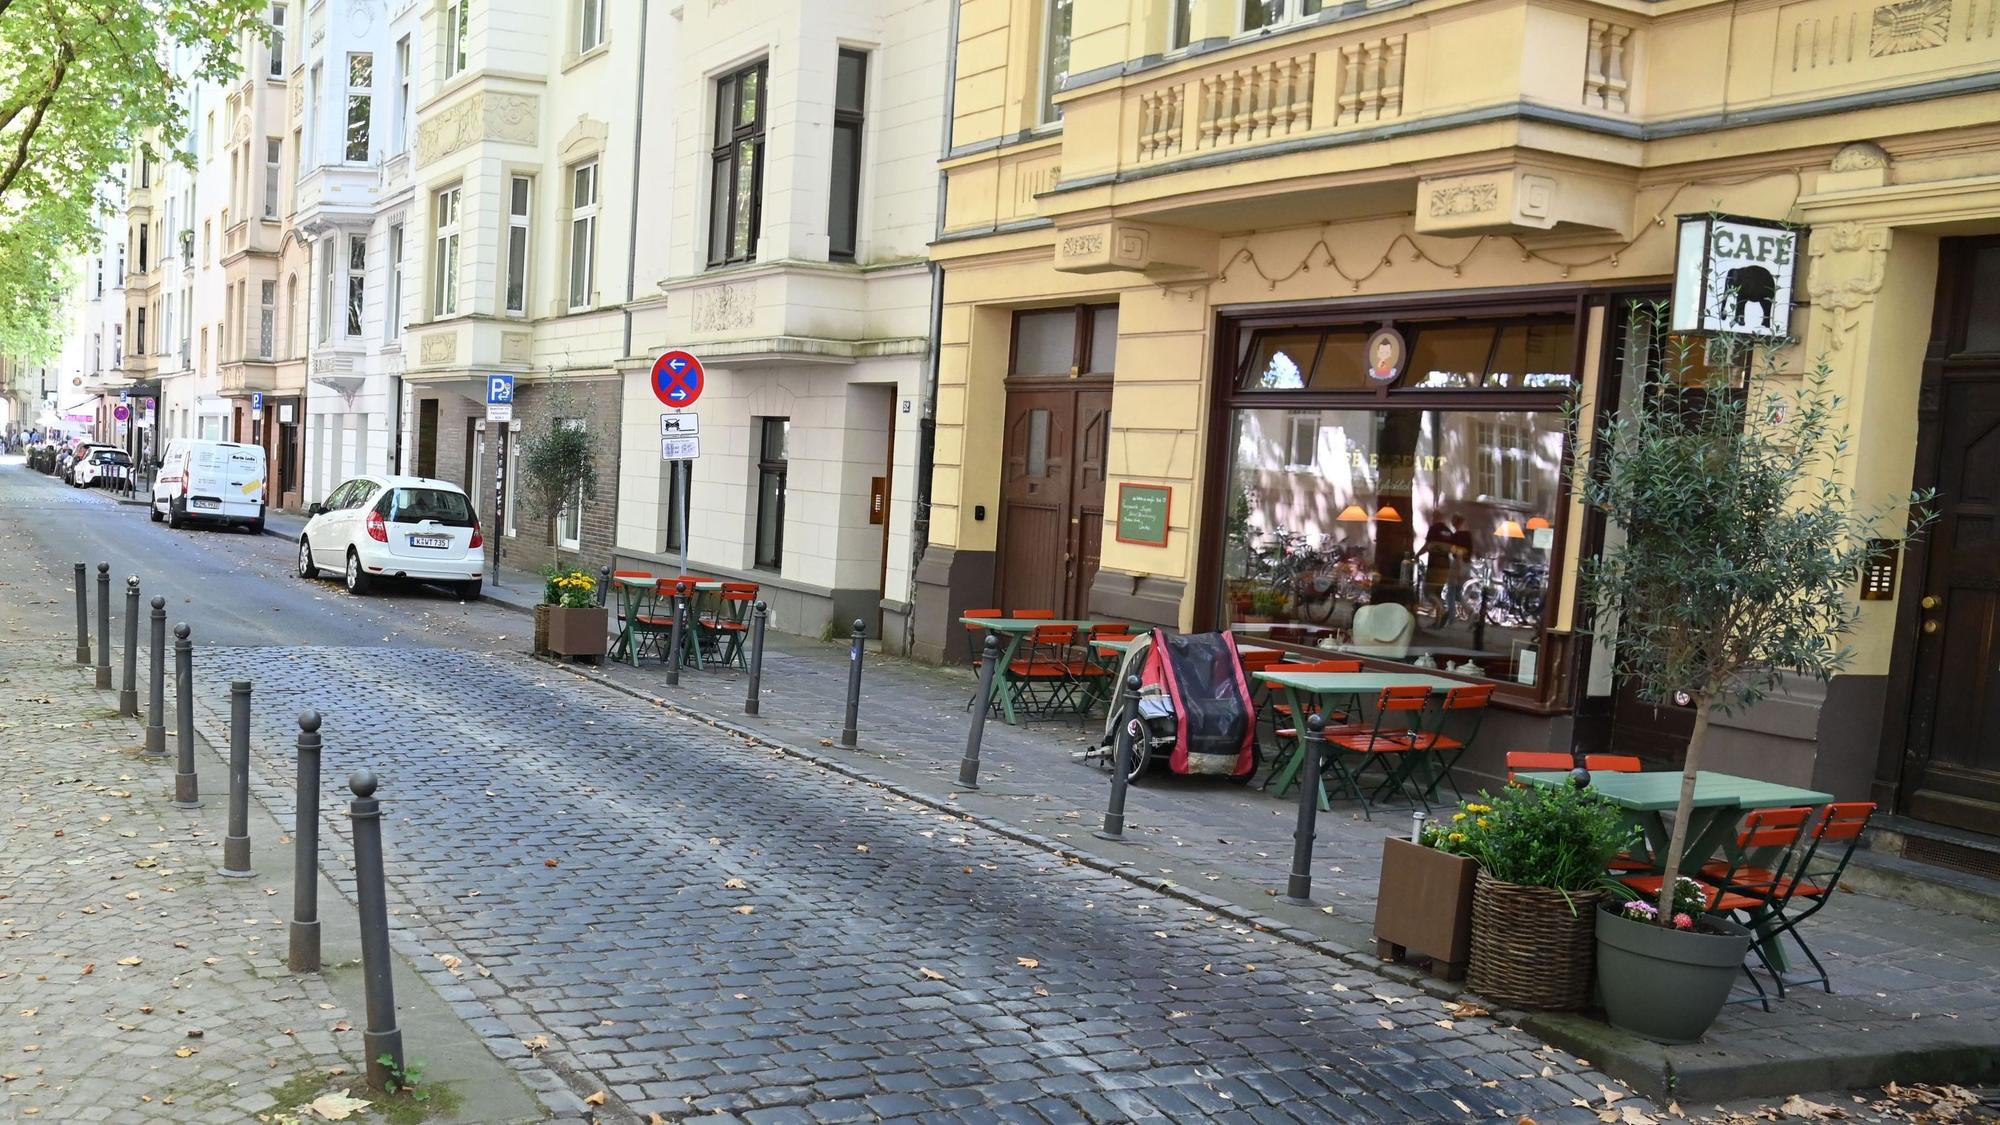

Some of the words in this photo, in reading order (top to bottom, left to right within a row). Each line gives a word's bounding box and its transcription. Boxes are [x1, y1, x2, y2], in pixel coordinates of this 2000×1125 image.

[1713, 229, 1792, 265] CAFÉ
[491, 378, 505, 401] P
[434, 539, 446, 547] 735
